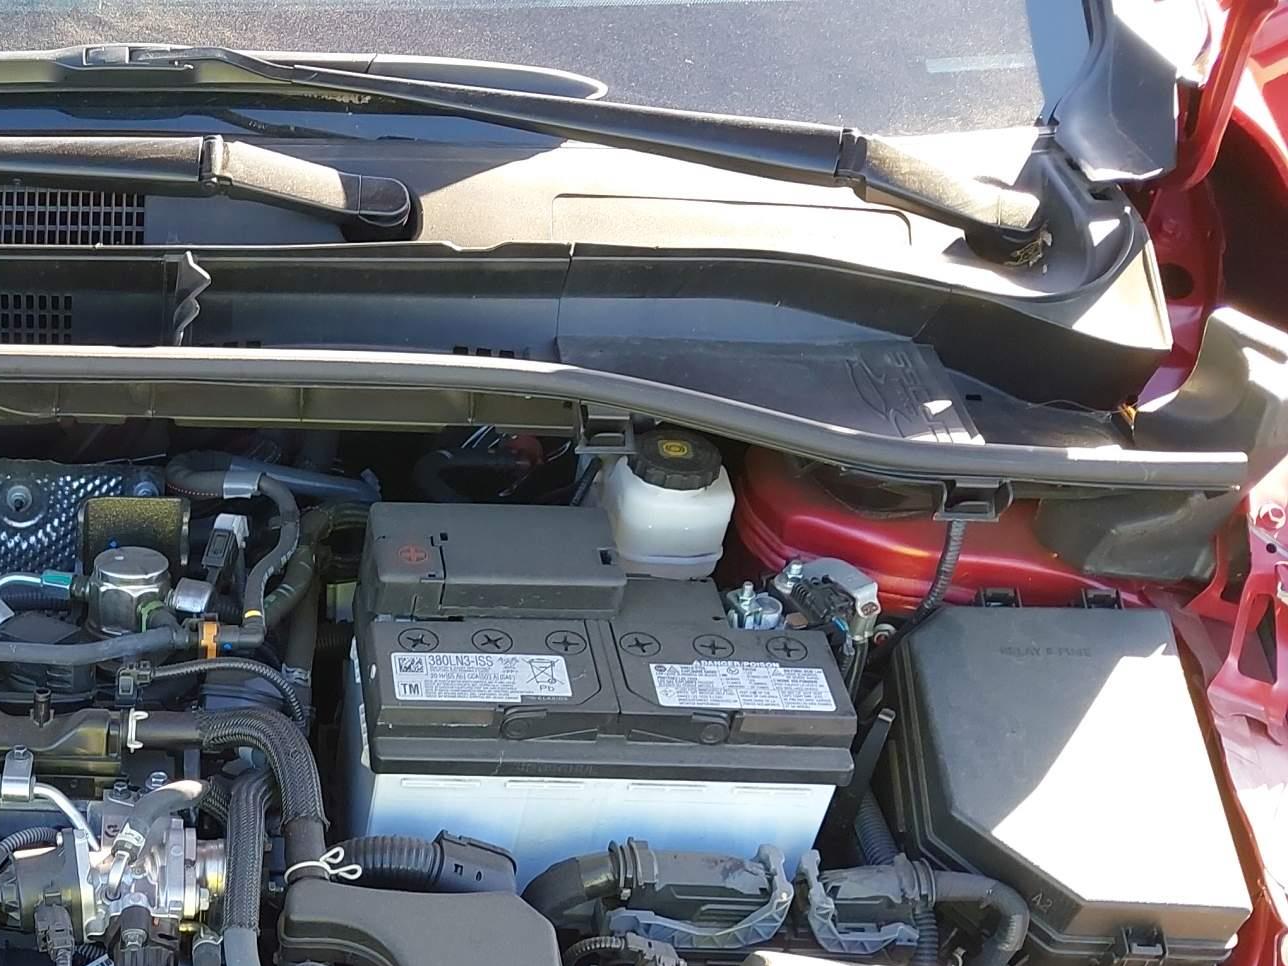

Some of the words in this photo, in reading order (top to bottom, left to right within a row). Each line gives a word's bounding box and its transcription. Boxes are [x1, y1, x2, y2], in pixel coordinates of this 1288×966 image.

[428, 654, 494, 667] 380LN3-ISS
[400, 683, 420, 695] TM
[539, 684, 555, 693] Pb
